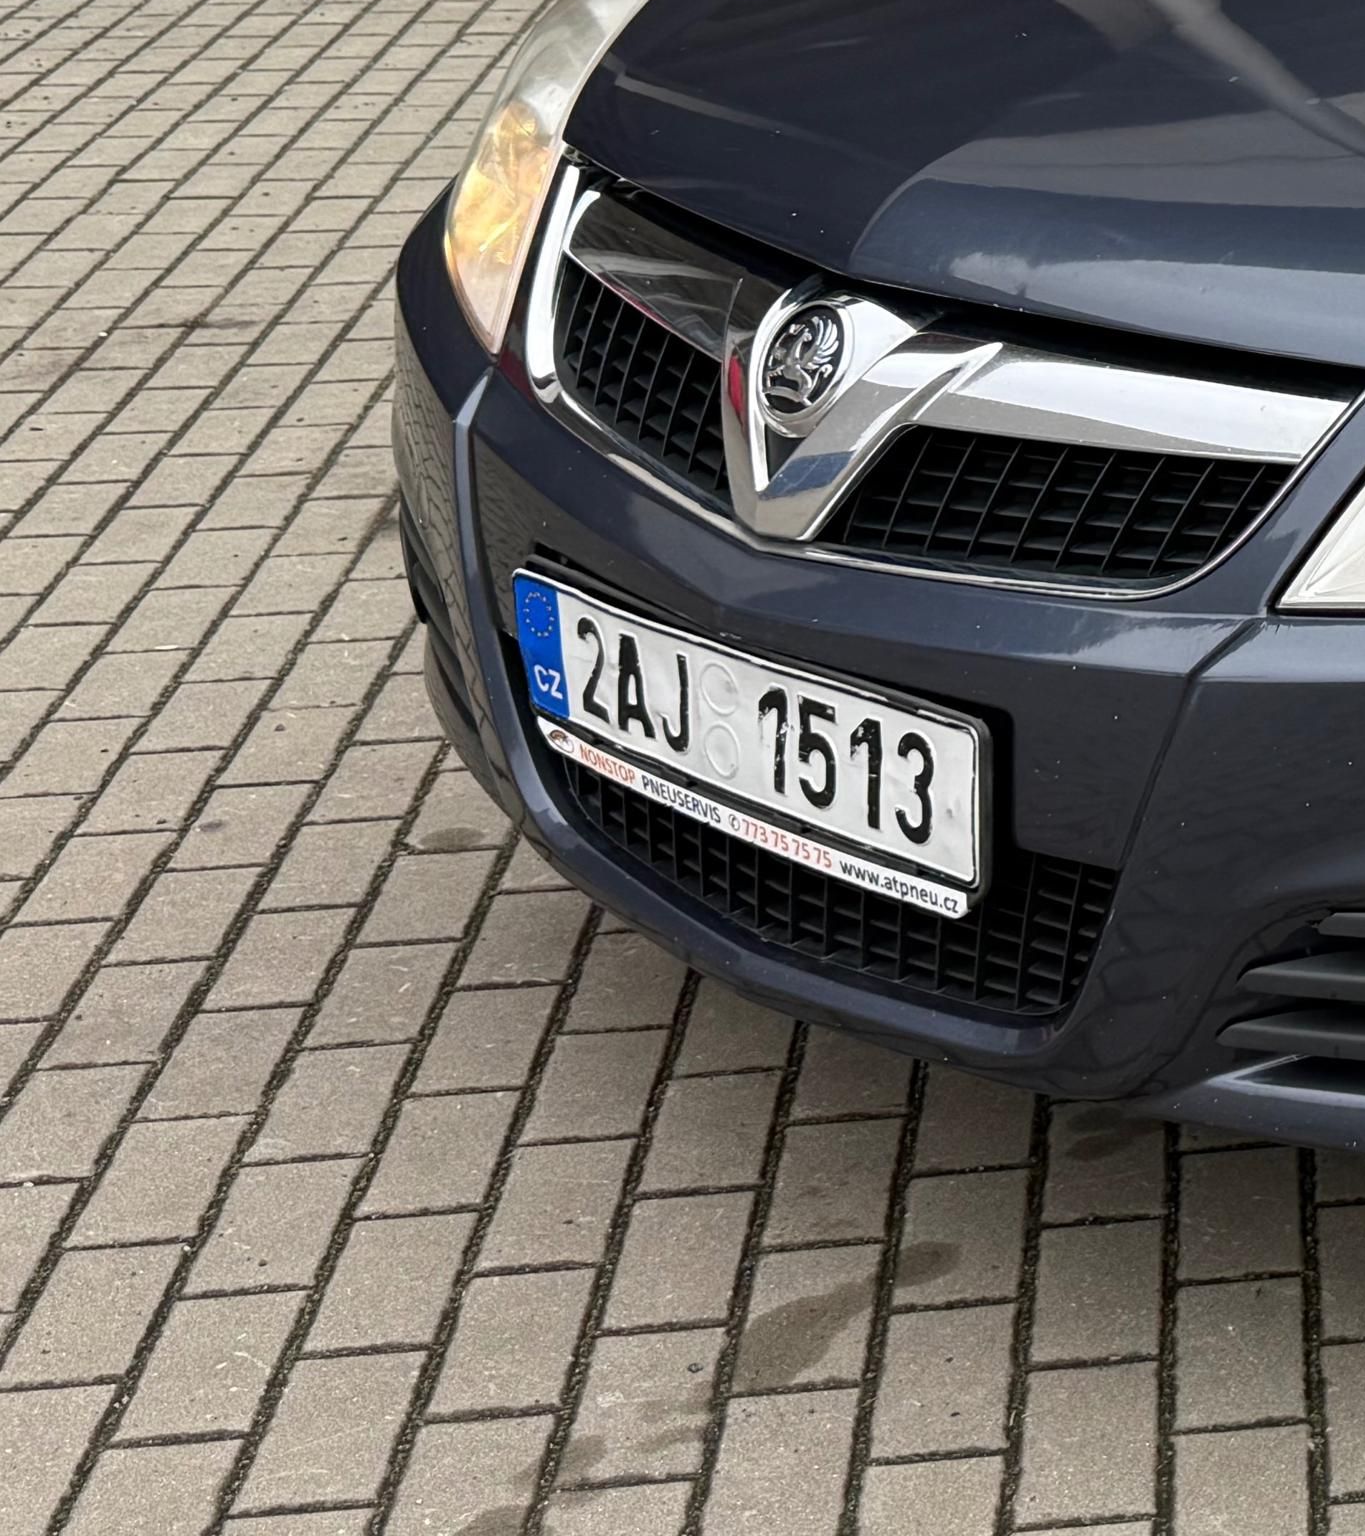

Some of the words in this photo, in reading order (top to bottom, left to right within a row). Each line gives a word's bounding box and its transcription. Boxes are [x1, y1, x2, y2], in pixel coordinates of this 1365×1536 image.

[534, 664, 563, 699] CZ
[576, 616, 690, 753] 2AJ
[759, 683, 935, 846] 1513
[580, 743, 636, 784] NONSTOP
[641, 774, 721, 824] PNEUSERVIS
[742, 818, 768, 843] 773
[839, 860, 959, 915] www.atpneu.cz
